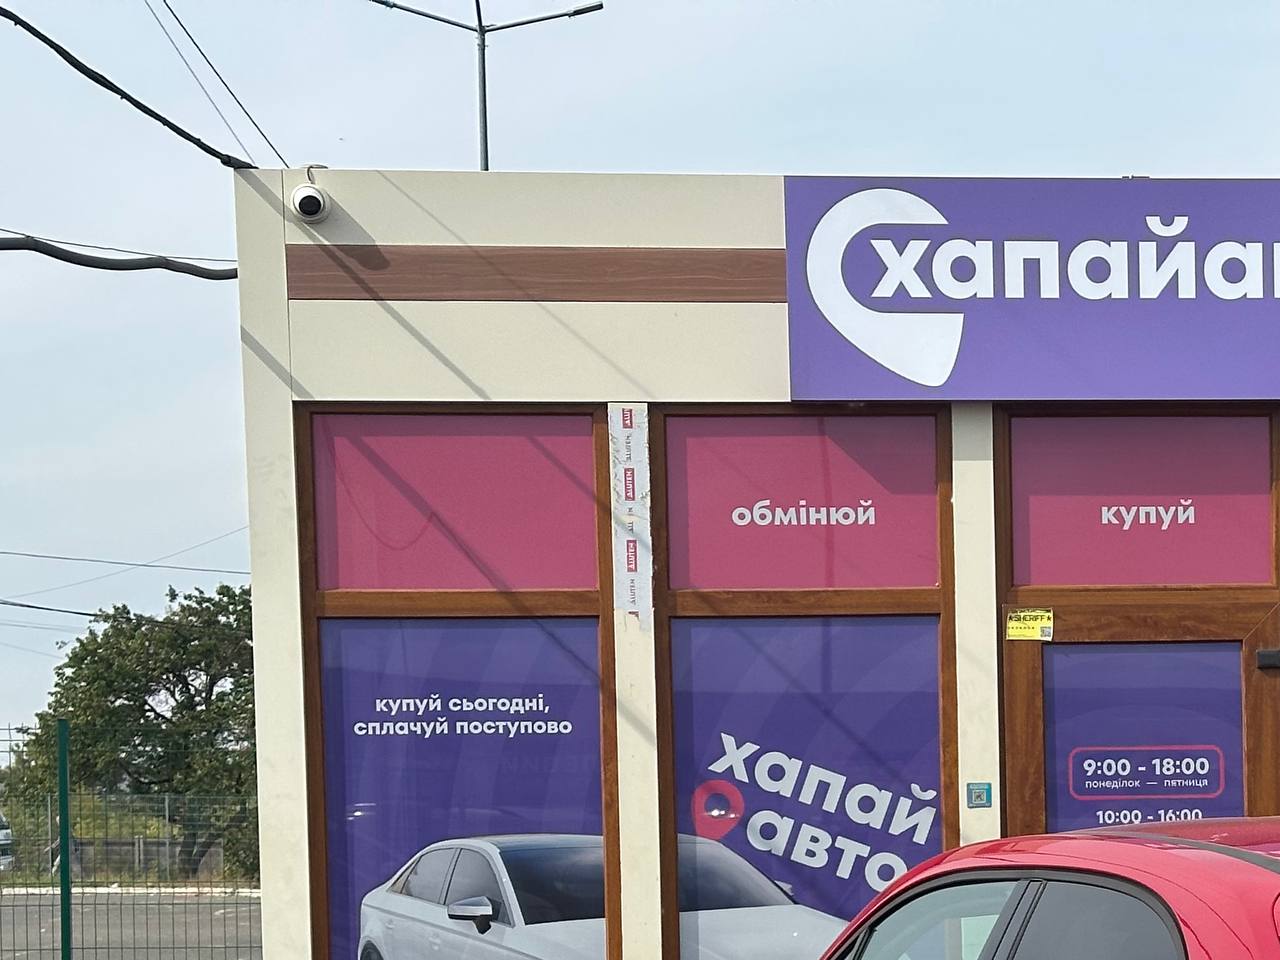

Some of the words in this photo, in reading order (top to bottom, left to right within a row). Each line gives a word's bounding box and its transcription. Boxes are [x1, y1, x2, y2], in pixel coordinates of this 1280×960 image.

[731, 499, 876, 526] обмінюй
[1101, 499, 1195, 530] купуй
[376, 694, 442, 716] купуй
[448, 694, 550, 714] сьогодні,
[353, 717, 449, 738] сплачуй
[455, 720, 573, 738] поступово
[1083, 759, 1131, 776] 9:00
[1151, 758, 1210, 775] 18:00
[707, 732, 937, 845] хапай
[1085, 778, 1141, 790] понеділок
[1096, 809, 1142, 824] 10:00
[1158, 808, 1203, 823] 16:00
[746, 810, 908, 893] авто
